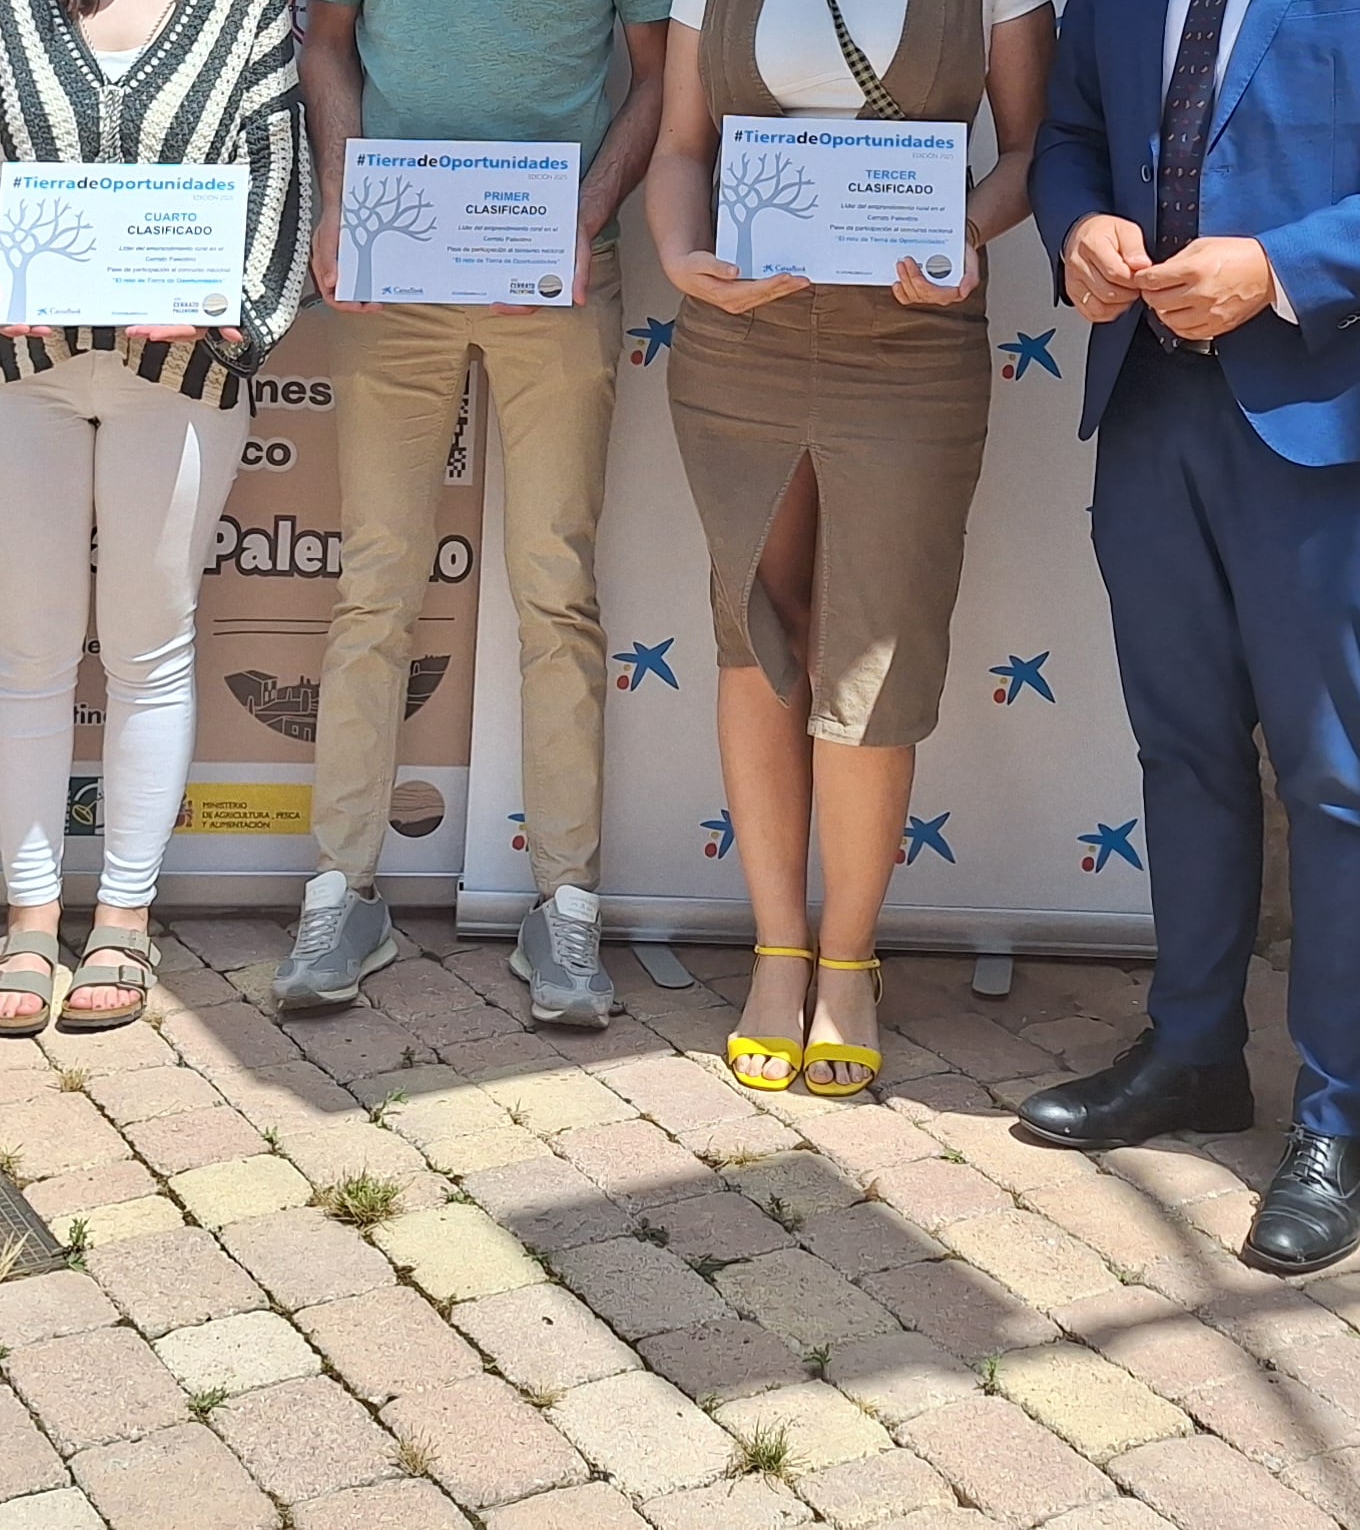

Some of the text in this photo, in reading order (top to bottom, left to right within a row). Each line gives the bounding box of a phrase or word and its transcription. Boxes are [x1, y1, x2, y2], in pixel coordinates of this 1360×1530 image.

[734, 130, 954, 149] #TierradeOportunidades
[357, 153, 569, 170] #TierradeOportunidades
[865, 169, 917, 180] TERCER
[13, 176, 235, 192] #TierradeOportunidades
[848, 182, 933, 195] CLASIFICADO
[483, 191, 530, 202] PRIMER
[465, 204, 547, 216] CLASIFICADO
[144, 212, 197, 222] CUARTO
[127, 225, 213, 236] CLASIFICADO
[202, 801, 248, 809] MINISTERIO
